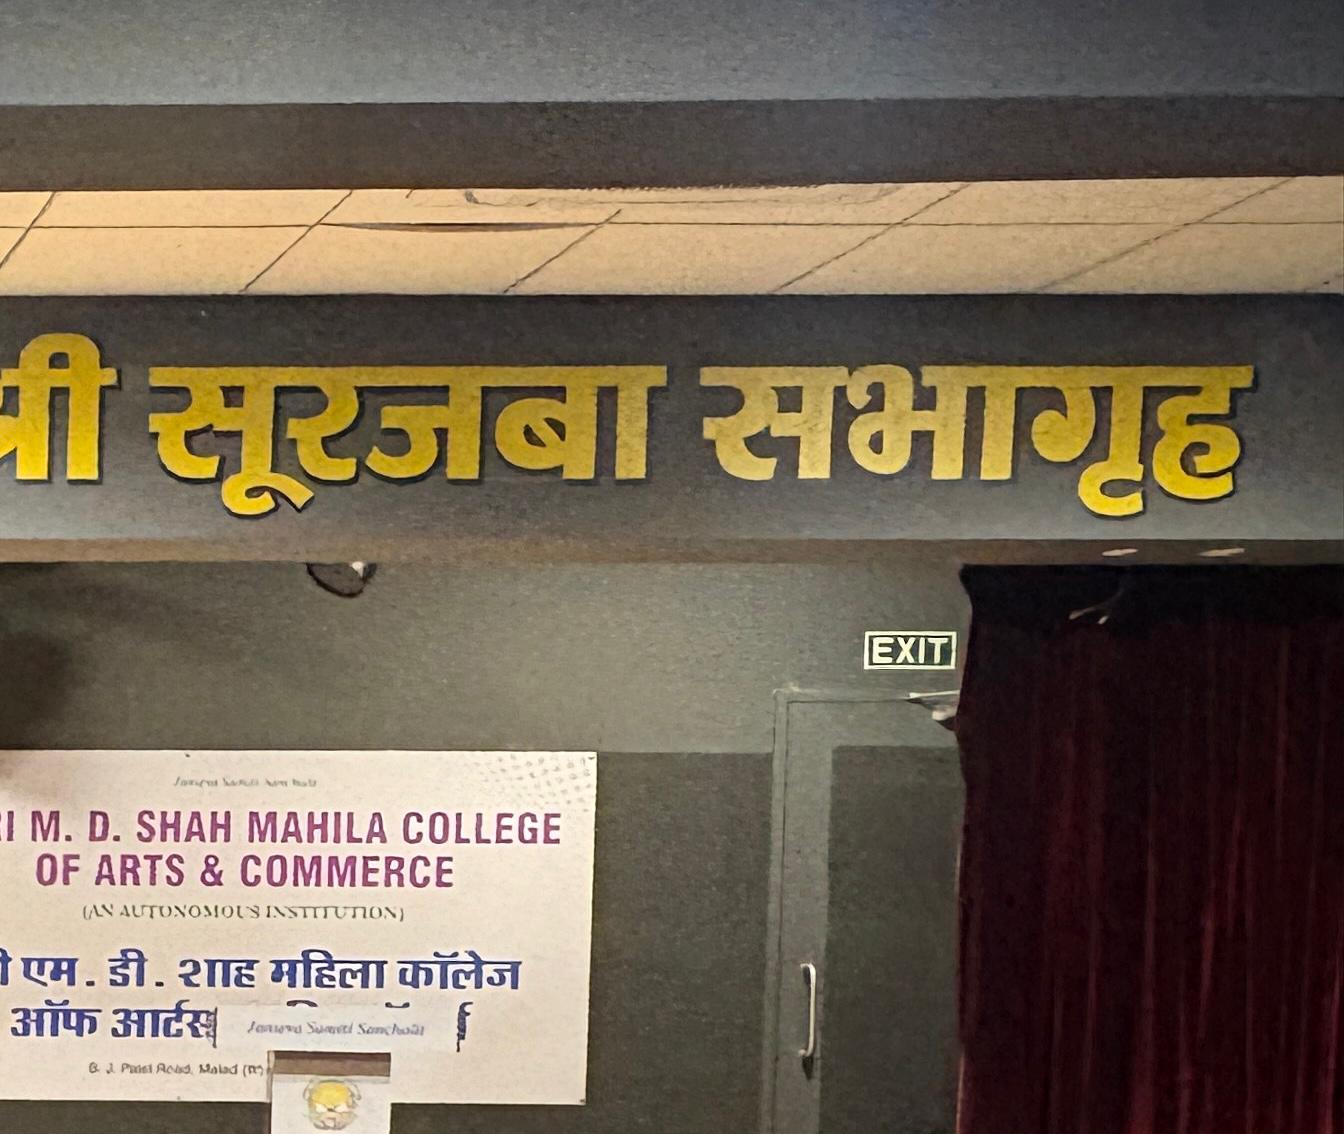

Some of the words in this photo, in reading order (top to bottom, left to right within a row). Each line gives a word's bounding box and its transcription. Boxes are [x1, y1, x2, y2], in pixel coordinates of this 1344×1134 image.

[148, 365, 667, 518] सूरजबा
[700, 364, 1254, 518] सभागृह
[872, 636, 948, 664] EXIT
[30, 809, 73, 843] M.
[88, 809, 121, 843] D.
[136, 809, 232, 844] SHAH
[247, 810, 388, 845] MAHILA
[402, 811, 562, 846] COLLEGE
[35, 852, 81, 888] OF
[94, 853, 185, 888] ARTS
[199, 854, 225, 887] &
[240, 854, 454, 889] COMMERCE
[82, 903, 114, 921] (AN
[119, 903, 261, 921] AUTONOMOUS
[265, 904, 405, 922] INSTITUTION)
[177, 958, 261, 989] शाह
[268, 948, 389, 990] महिला
[396, 949, 523, 991] कॉलेज
[10, 998, 103, 1038] ऑफ
